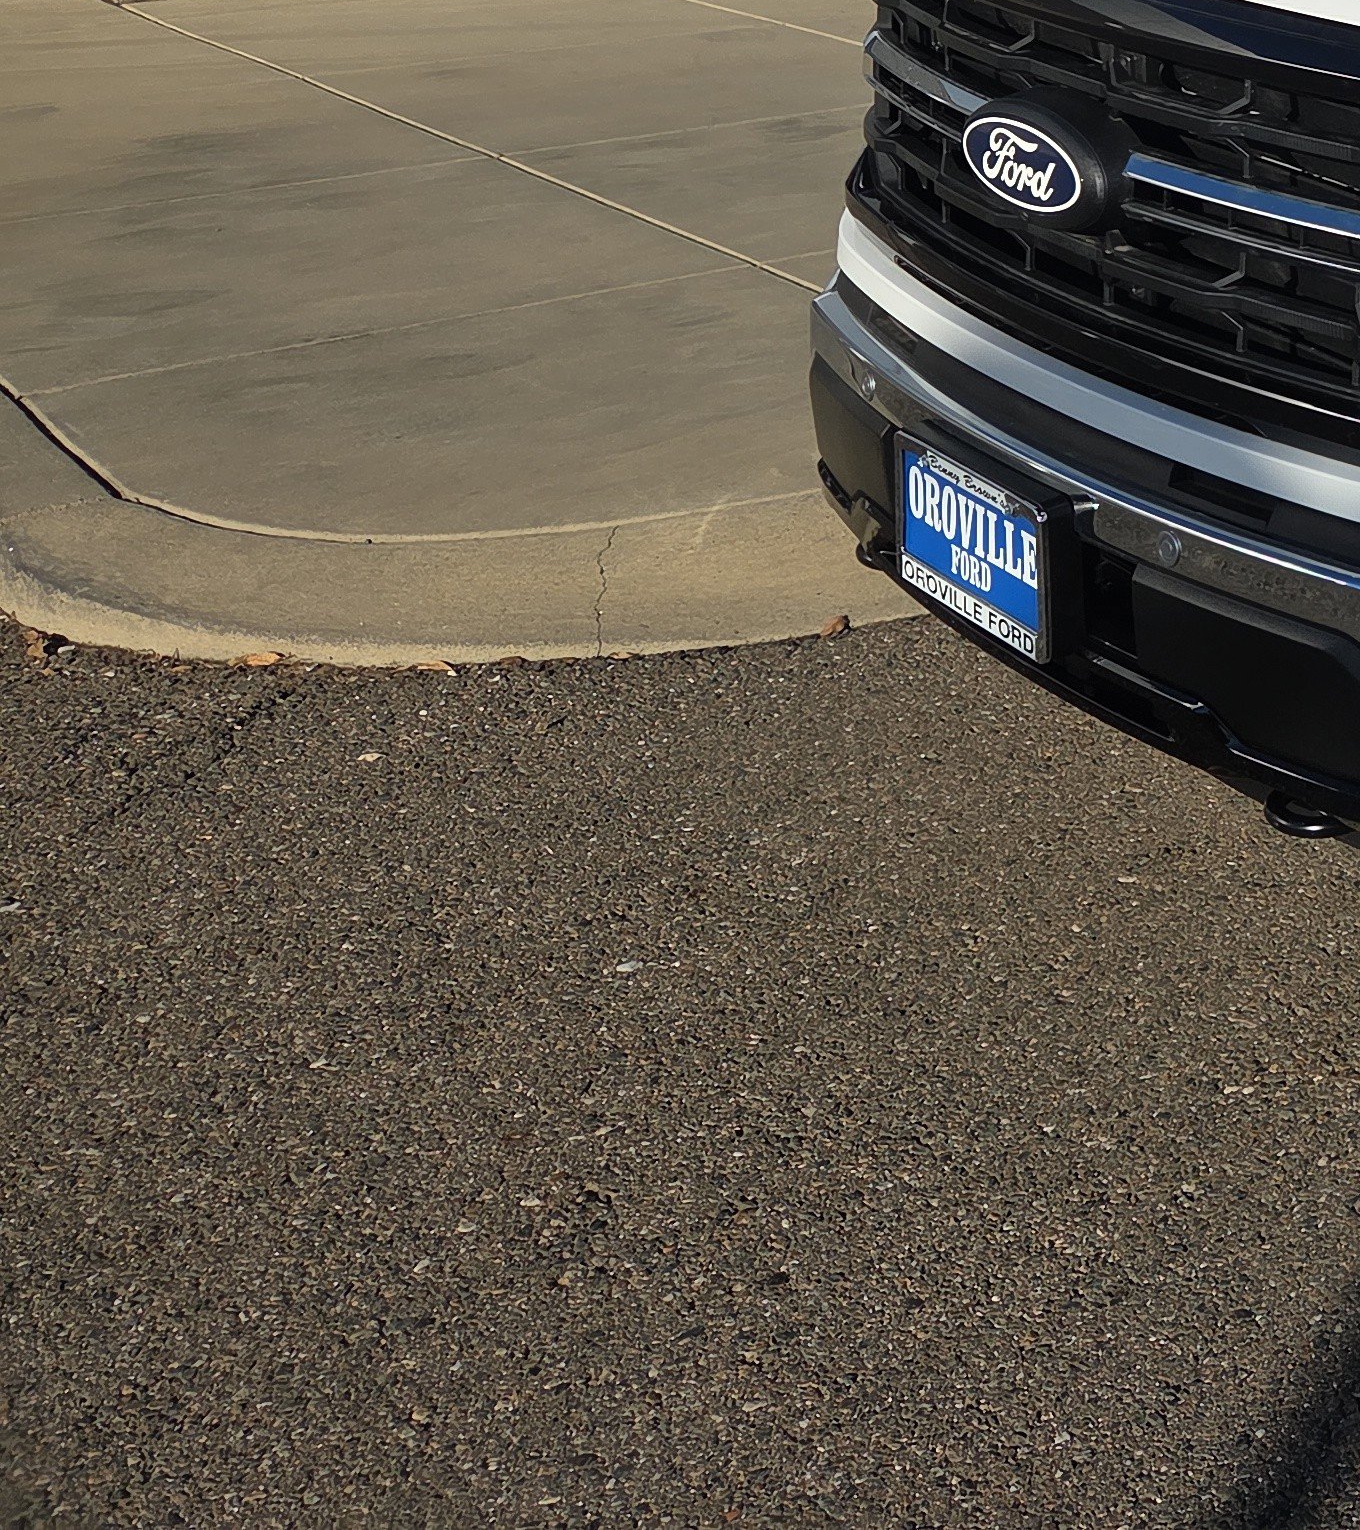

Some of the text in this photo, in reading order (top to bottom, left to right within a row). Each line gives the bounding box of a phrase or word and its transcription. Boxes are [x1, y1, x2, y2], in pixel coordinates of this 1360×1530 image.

[982, 127, 1056, 201] Ford
[909, 465, 1038, 590] OROVILLE
[950, 543, 991, 593] FORD
[904, 560, 1034, 655] OROVILLE FORD
